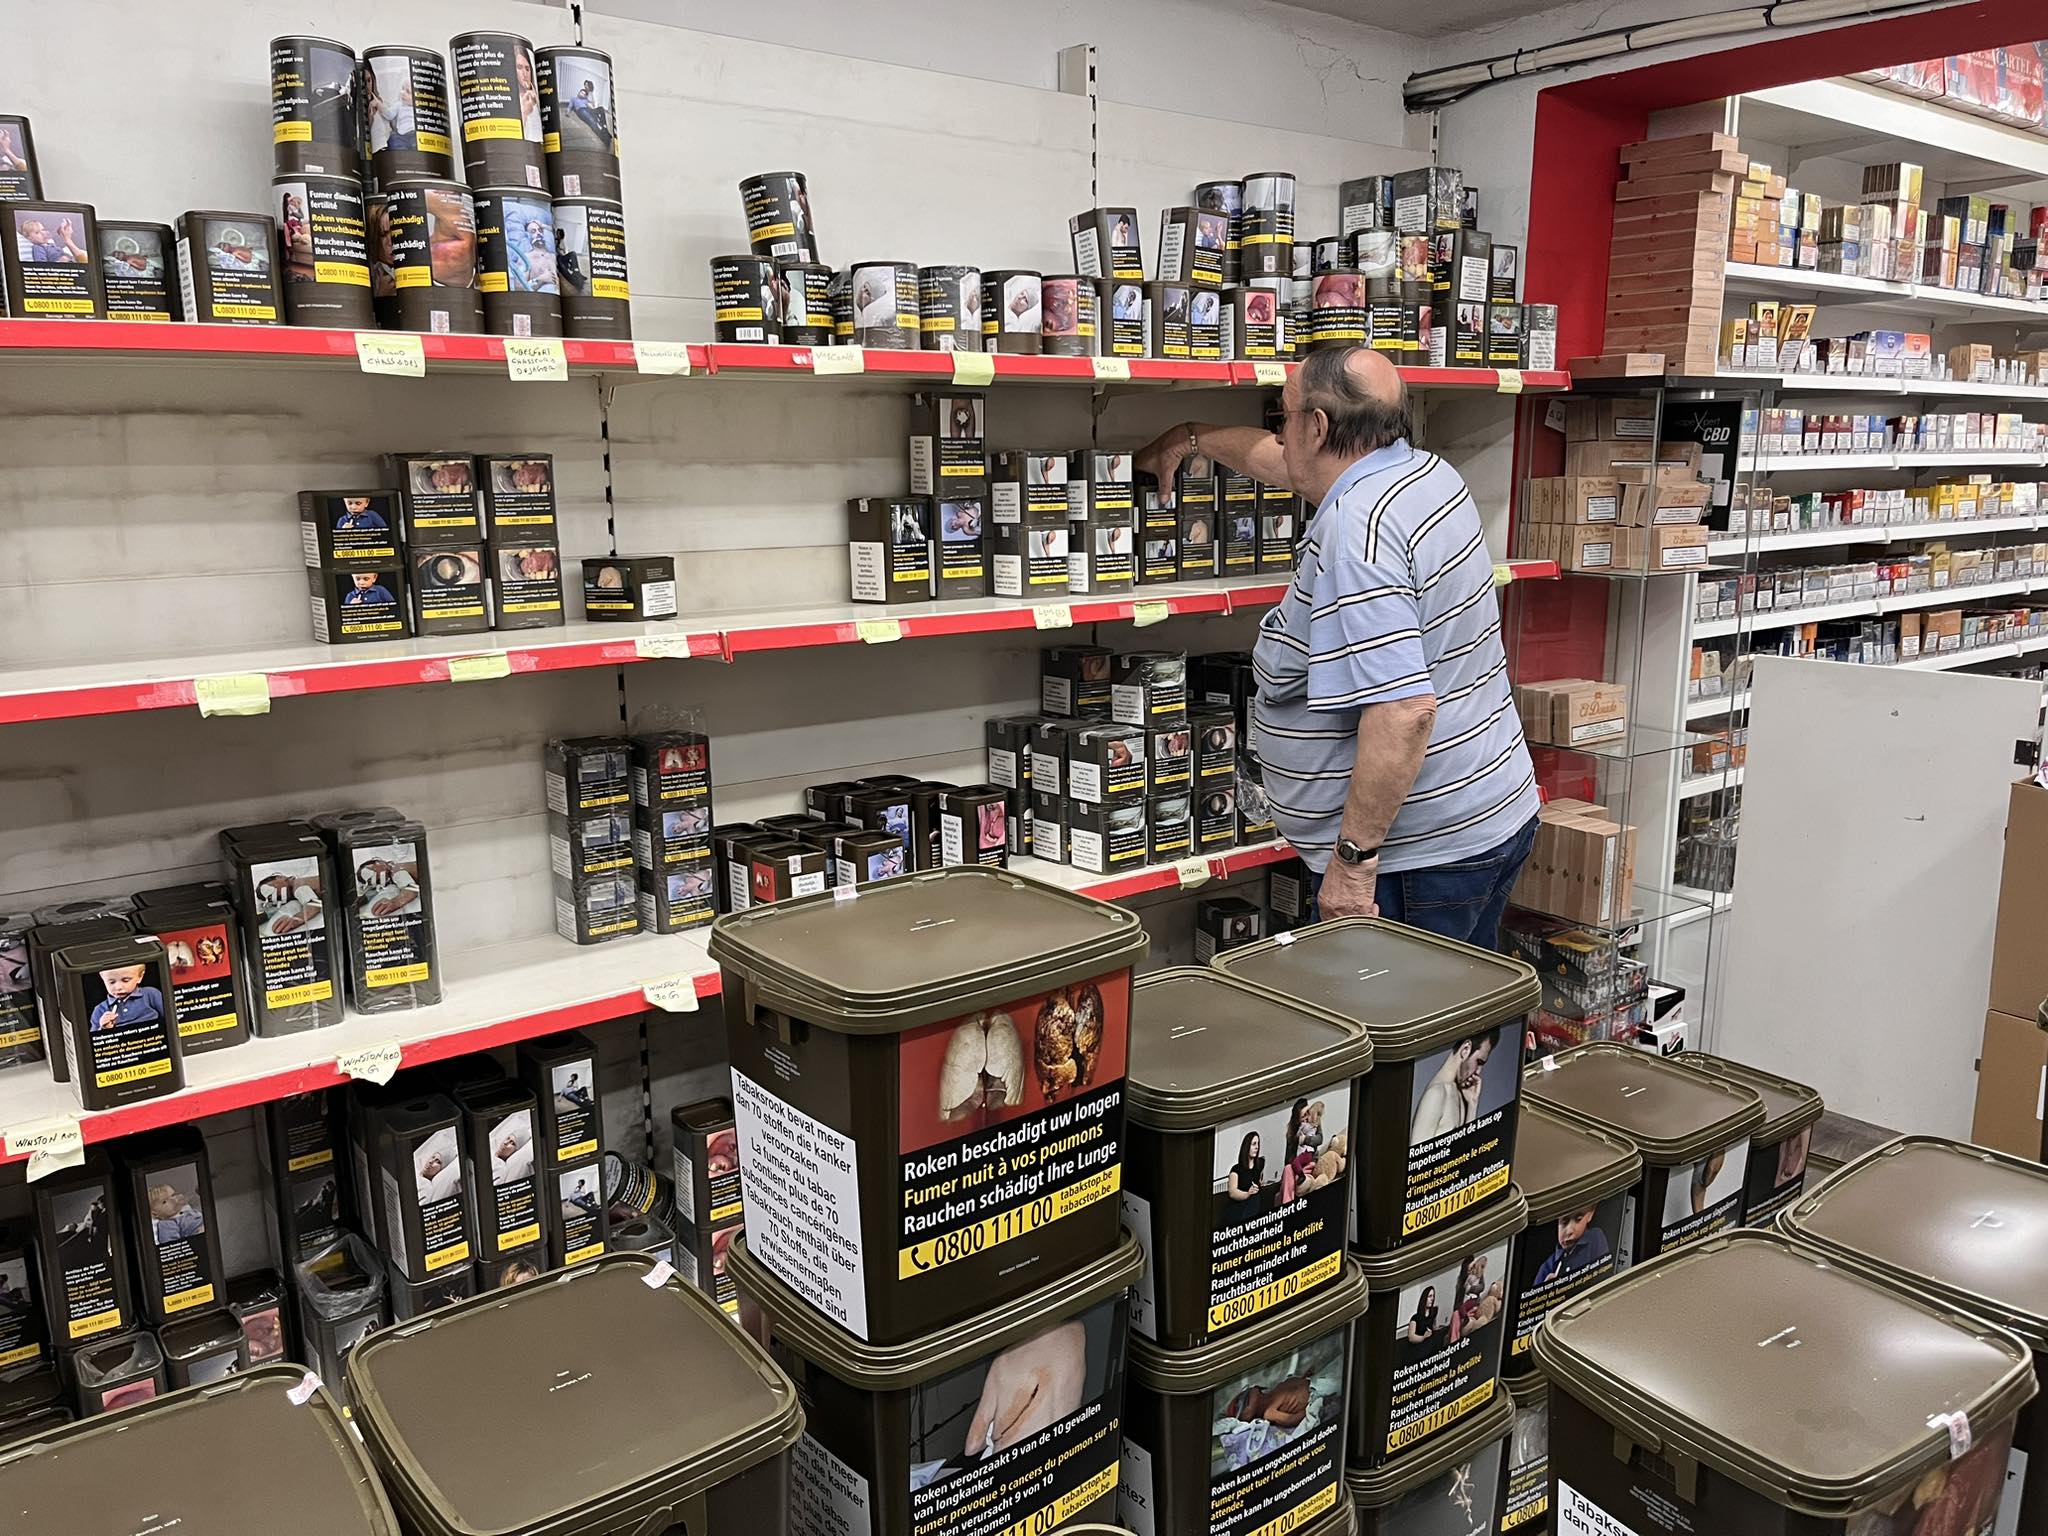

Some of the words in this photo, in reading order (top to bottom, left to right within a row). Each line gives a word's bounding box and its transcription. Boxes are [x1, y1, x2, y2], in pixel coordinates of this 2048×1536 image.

[1703, 427, 1730, 441] CBD
[275, 993, 291, 1002] 0800
[292, 991, 301, 999] 111
[106, 1074, 123, 1082] 0800
[344, 1048, 385, 1067] WINSTON
[735, 1093, 750, 1111] dan
[752, 1104, 761, 1119] 70
[763, 1114, 794, 1141] stoffen
[797, 1133, 812, 1152] die
[814, 1142, 852, 1174] kanker
[736, 1074, 785, 1118] Tabaksrook
[787, 1107, 815, 1135] bevat
[817, 1130, 846, 1151] meer
[1409, 1143, 1434, 1158] Roken
[1435, 1129, 1466, 1147] vergroot
[1467, 1124, 1476, 1134] de
[1477, 1117, 1493, 1129] kans
[1493, 1111, 1502, 1122] op
[16, 1133, 57, 1147] WINSTON
[762, 1129, 818, 1174] veroorzaken
[904, 1152, 957, 1182] Roken
[962, 1118, 1047, 1163] beschadigt
[1050, 1112, 1072, 1131] uw
[1075, 1091, 1120, 1123] longen
[1408, 1148, 1451, 1171] impotentie
[751, 1137, 761, 1154] La
[763, 1147, 791, 1175] fumée
[793, 1170, 805, 1185] du
[808, 1176, 836, 1205] tabac
[904, 1179, 958, 1209] Fumer
[962, 1163, 994, 1189] nuit
[998, 1157, 1007, 1176] à
[1011, 1150, 1037, 1171] vos
[1040, 1123, 1104, 1165] poumons
[1406, 1169, 1460, 1198] d'impuissance
[1407, 1170, 1432, 1185] Fumer
[1433, 1153, 1470, 1174] augmente
[1471, 1148, 1477, 1158] le
[1478, 1138, 1499, 1154] risque
[752, 1158, 786, 1191] contient
[789, 1183, 809, 1206] plus
[811, 1199, 823, 1216] de
[826, 1207, 839, 1225] 70
[904, 1194, 976, 1235] Rauchen
[979, 1172, 1044, 1209] schädigt
[1048, 1162, 1074, 1183] Ihre
[1078, 1142, 1118, 1170] Lunge
[1060, 1170, 1113, 1201] tabakstop.be
[1060, 1185, 1112, 1214] tabacstop.be
[1405, 1193, 1438, 1213] Rauchen
[1440, 1178, 1468, 1196] bedroht
[1468, 1171, 1482, 1184] Ihre
[1482, 1159, 1505, 1175] Potenz
[1415, 1204, 1440, 1226] 0800
[1444, 1195, 1461, 1214] 111
[1463, 1186, 1475, 1203] 00
[742, 1166, 788, 1209] substances
[790, 1204, 858, 1255] cancérigènes
[746, 1184, 794, 1229] Tabakrauch
[796, 1226, 829, 1256] enthält
[832, 1248, 856, 1273] über
[934, 1223, 985, 1266] 0800
[992, 1208, 1024, 1243] 111
[1031, 1196, 1053, 1228] 00
[1212, 1225, 1243, 1243] Roken
[1245, 1204, 1295, 1231] vermindert
[1296, 1198, 1308, 1210] de
[768, 1219, 779, 1237] 70
[781, 1232, 811, 1263] Stoffe,
[813, 1254, 828, 1273] die
[1211, 1256, 1242, 1275] Fumer
[1244, 1240, 1282, 1262] diminue
[1283, 1236, 1292, 1246] la
[1293, 1218, 1324, 1242] fertilité
[1212, 1221, 1284, 1258] vruchtbaarheid
[759, 1244, 823, 1305] krebserregend
[826, 1299, 847, 1322] sind
[760, 1233, 842, 1301] erwiesenermaßen
[1211, 1268, 1252, 1291] Rauchen
[1254, 1251, 1289, 1274] mindert
[1291, 1244, 1308, 1258] Ihre
[1211, 1272, 1273, 1306] Fruchtbarkeit
[1223, 1295, 1255, 1322] 0800
[1259, 1286, 1279, 1308] 111
[1284, 1275, 1298, 1296] 00
[1392, 1358, 1450, 1392] vruchtbaarheid
[1394, 1364, 1418, 1380] Roken
[1419, 1345, 1460, 1367] vermindert
[1389, 1401, 1440, 1432] Fruchtbarkeit
[1390, 1399, 1424, 1420] Rauchen
[1425, 1384, 1454, 1403] mindert
[1391, 1389, 1417, 1406] Fumer
[1399, 1420, 1425, 1445] 0800
[1428, 1411, 1445, 1430] 111
[1448, 1402, 1459, 1418] 00
[914, 1486, 948, 1507] Roken
[950, 1454, 1010, 1490] veroorzaakt
[1011, 1449, 1018, 1460] 9
[1020, 1442, 1037, 1456] van
[1039, 1431, 1051, 1446] de
[1053, 1424, 1064, 1437] 10
[1065, 1404, 1101, 1433] gevallen
[914, 1516, 949, 1536] Fumer
[950, 1490, 998, 1522] provoque
[1000, 1485, 1007, 1496] 9
[1008, 1467, 1043, 1492] cancers
[1044, 1459, 1056, 1472] du
[1057, 1437, 1094, 1466] poumon
[1095, 1427, 1108, 1442] sur
[1109, 1417, 1119, 1433] 10
[1211, 1479, 1236, 1496] Roken
[1236, 1472, 1251, 1485] kan
[1251, 1466, 1264, 1477] uw
[1264, 1447, 1302, 1471] ongeboren
[1302, 1435, 1317, 1450] kind
[1317, 1424, 1338, 1441] doden
[1211, 1491, 1236, 1509] Fumer
[1236, 1483, 1254, 1499] peut
[1255, 1475, 1270, 1489] tuer
[1270, 1461, 1297, 1482] l'enfant
[1297, 1453, 1311, 1467] que
[1311, 1443, 1327, 1457] vous
[913, 1506, 934, 1521] van
[936, 1475, 995, 1515] longkanker
[961, 1496, 1014, 1532] verursacht
[1015, 1490, 1021, 1502] 9
[1023, 1485, 1040, 1499] von
[1042, 1473, 1054, 1488] 10
[1061, 1469, 1112, 1506] tabakstop.be
[1061, 1481, 1111, 1519] tabacstop.be
[1210, 1512, 1242, 1534] Rauchen
[1244, 1503, 1262, 1518] kann
[1263, 1495, 1273, 1507] Ihr
[1274, 1472, 1317, 1502] ungeborenes
[1317, 1460, 1332, 1476] Kind
[1210, 1500, 1245, 1521] attendez
